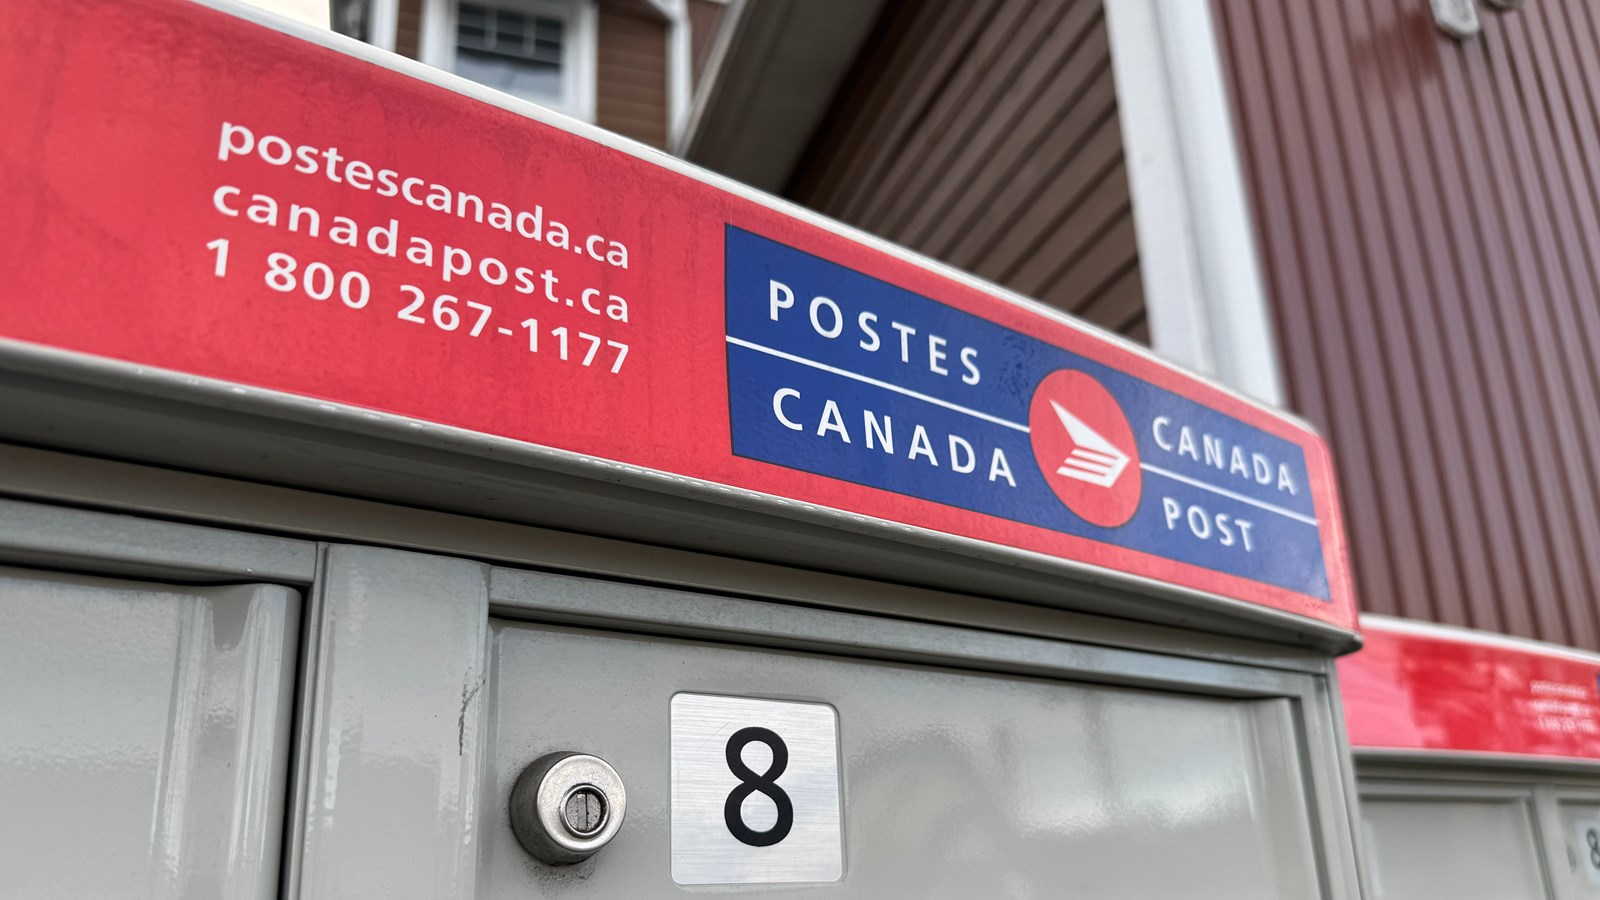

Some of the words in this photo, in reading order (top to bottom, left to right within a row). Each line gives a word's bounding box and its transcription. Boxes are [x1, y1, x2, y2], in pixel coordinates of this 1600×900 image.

[217, 121, 628, 270] postescanada.ca
[206, 238, 230, 277] 1
[264, 252, 371, 309] 800
[397, 284, 629, 374] 267-1177
[212, 185, 629, 323] canadapost.ca
[769, 279, 982, 386] POSTES
[772, 387, 1017, 488] CANADA
[1152, 415, 1298, 496] CANADA
[1162, 496, 1255, 553] POST
[723, 726, 794, 848] 8
